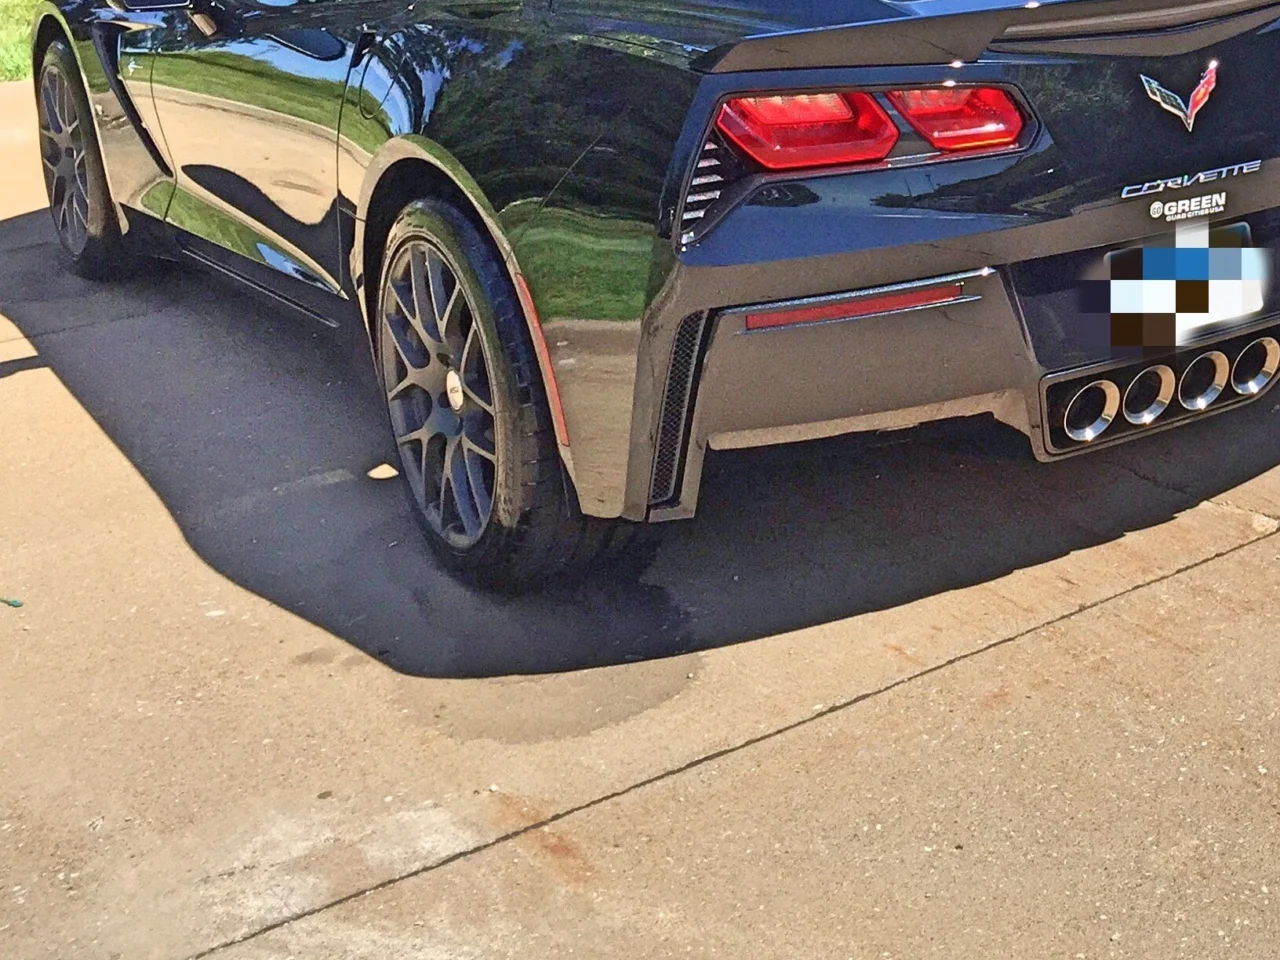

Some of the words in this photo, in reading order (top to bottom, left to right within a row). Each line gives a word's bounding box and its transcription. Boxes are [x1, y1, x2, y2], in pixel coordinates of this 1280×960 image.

[1121, 159, 1262, 199] CORVETTE
[1164, 192, 1226, 216] GREEN
[1165, 212, 1187, 222] QUAD
[1187, 208, 1210, 219] CITIES
[1209, 205, 1225, 214] USA
